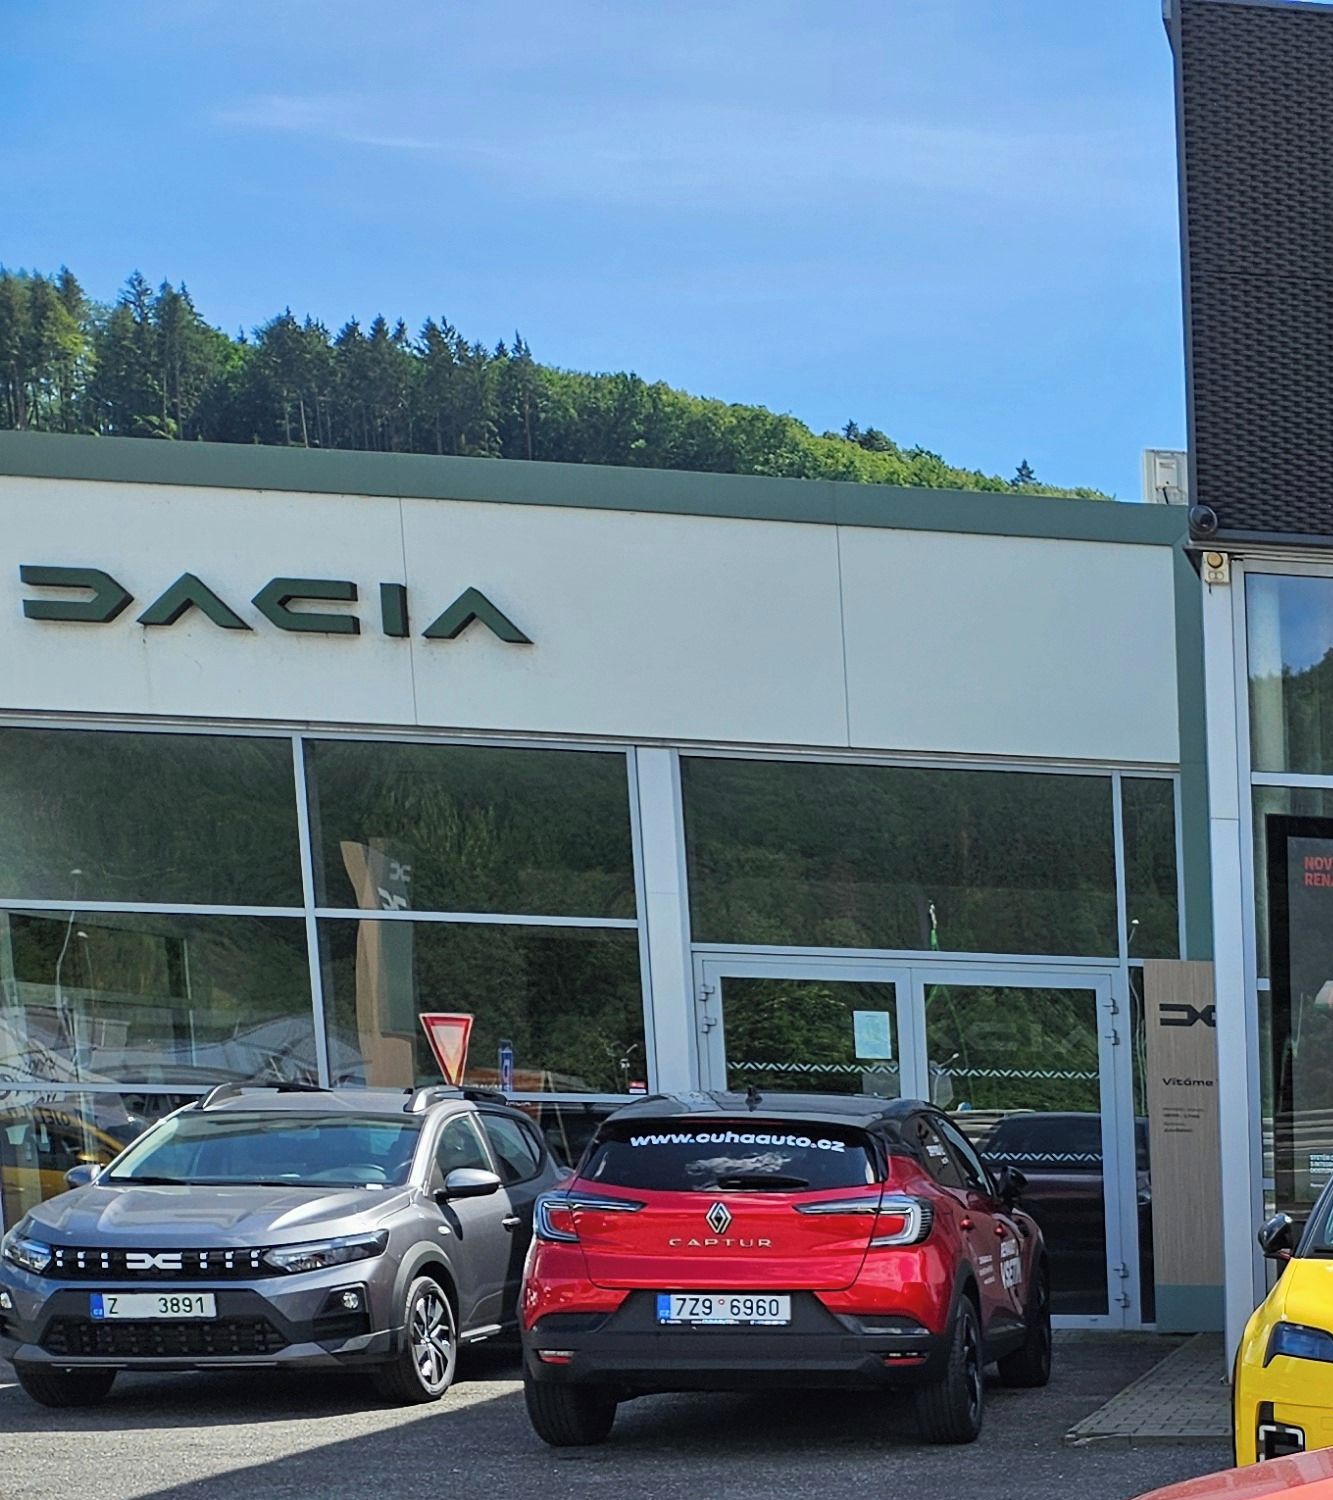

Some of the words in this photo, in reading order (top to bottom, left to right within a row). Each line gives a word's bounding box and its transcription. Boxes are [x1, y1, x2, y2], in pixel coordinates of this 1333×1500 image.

[19, 565, 534, 644] DACIA
[630, 1131, 846, 1153] www.cuhaauto.cz
[668, 1238, 772, 1248] CAPTUR
[107, 1298, 118, 1314] Z
[158, 1296, 205, 1314] 3891
[675, 1298, 713, 1316] 7Z9
[730, 1298, 779, 1317] 6960
